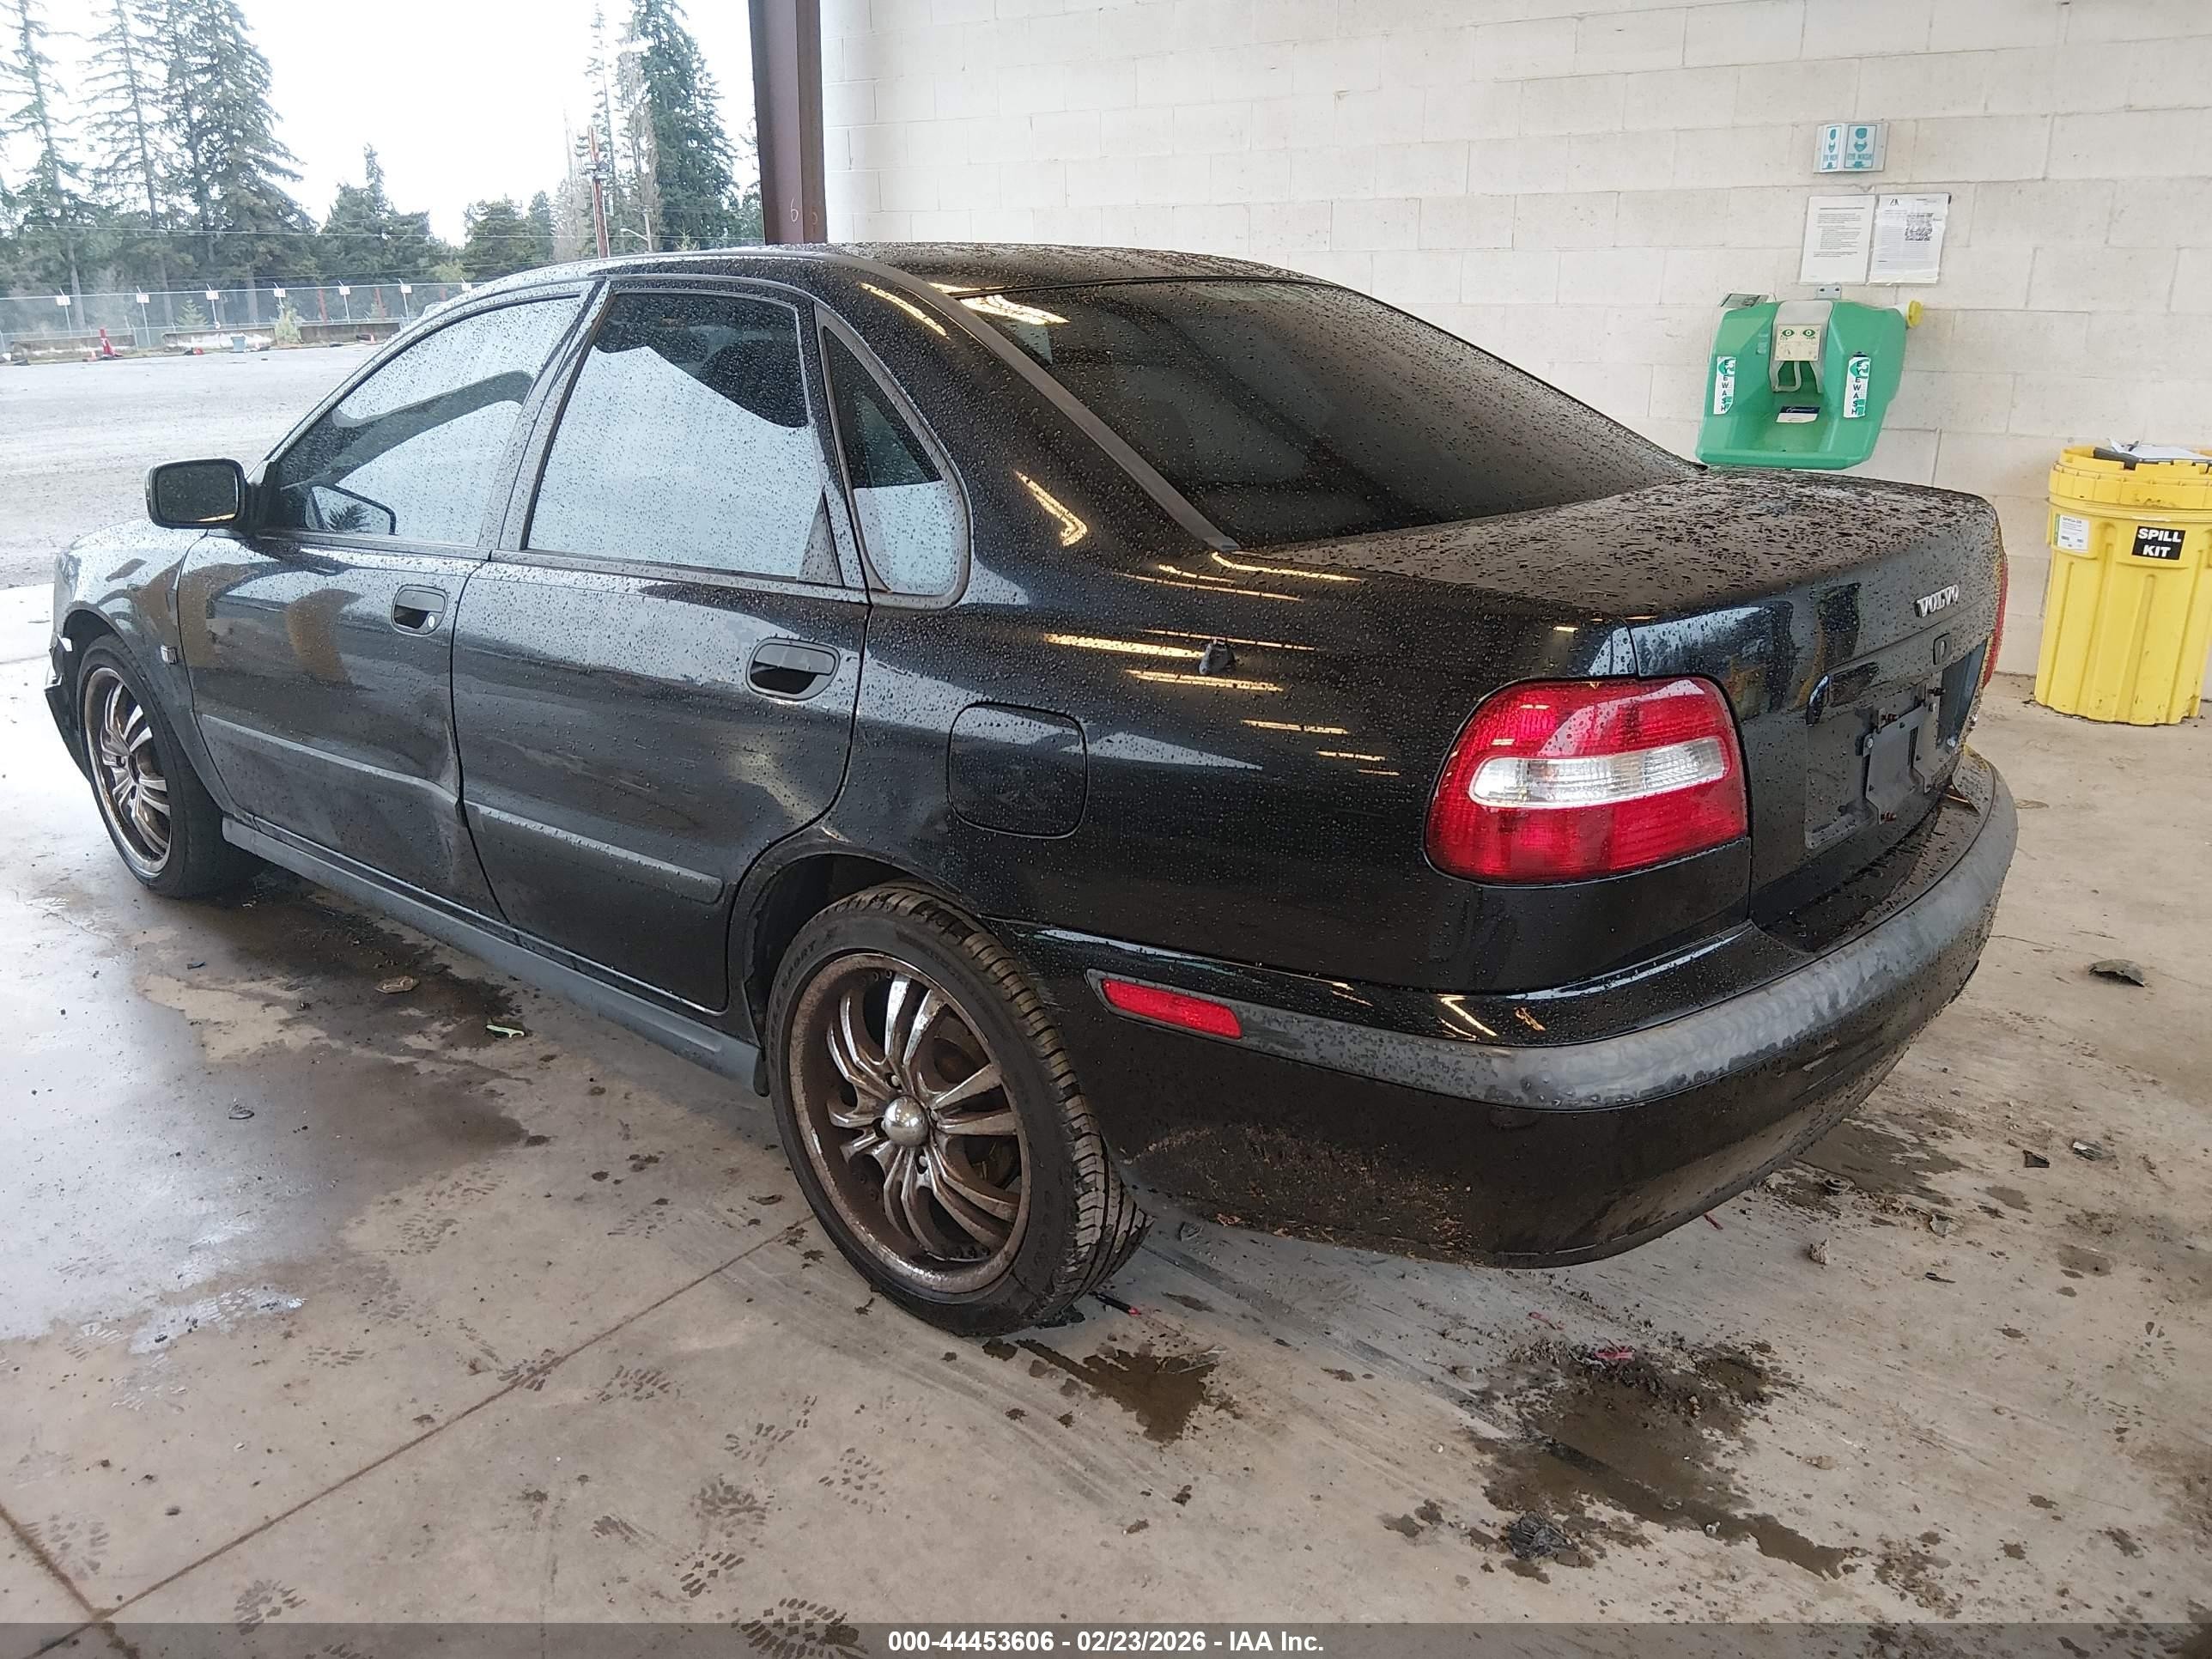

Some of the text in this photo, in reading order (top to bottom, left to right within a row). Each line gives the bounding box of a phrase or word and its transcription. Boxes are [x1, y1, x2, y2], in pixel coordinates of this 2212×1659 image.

[1850, 361, 1862, 415] EYEWASH
[2137, 527, 2182, 543] SPILL
[2142, 544, 2172, 557] KIT
[1917, 584, 1960, 617] VOLVO
